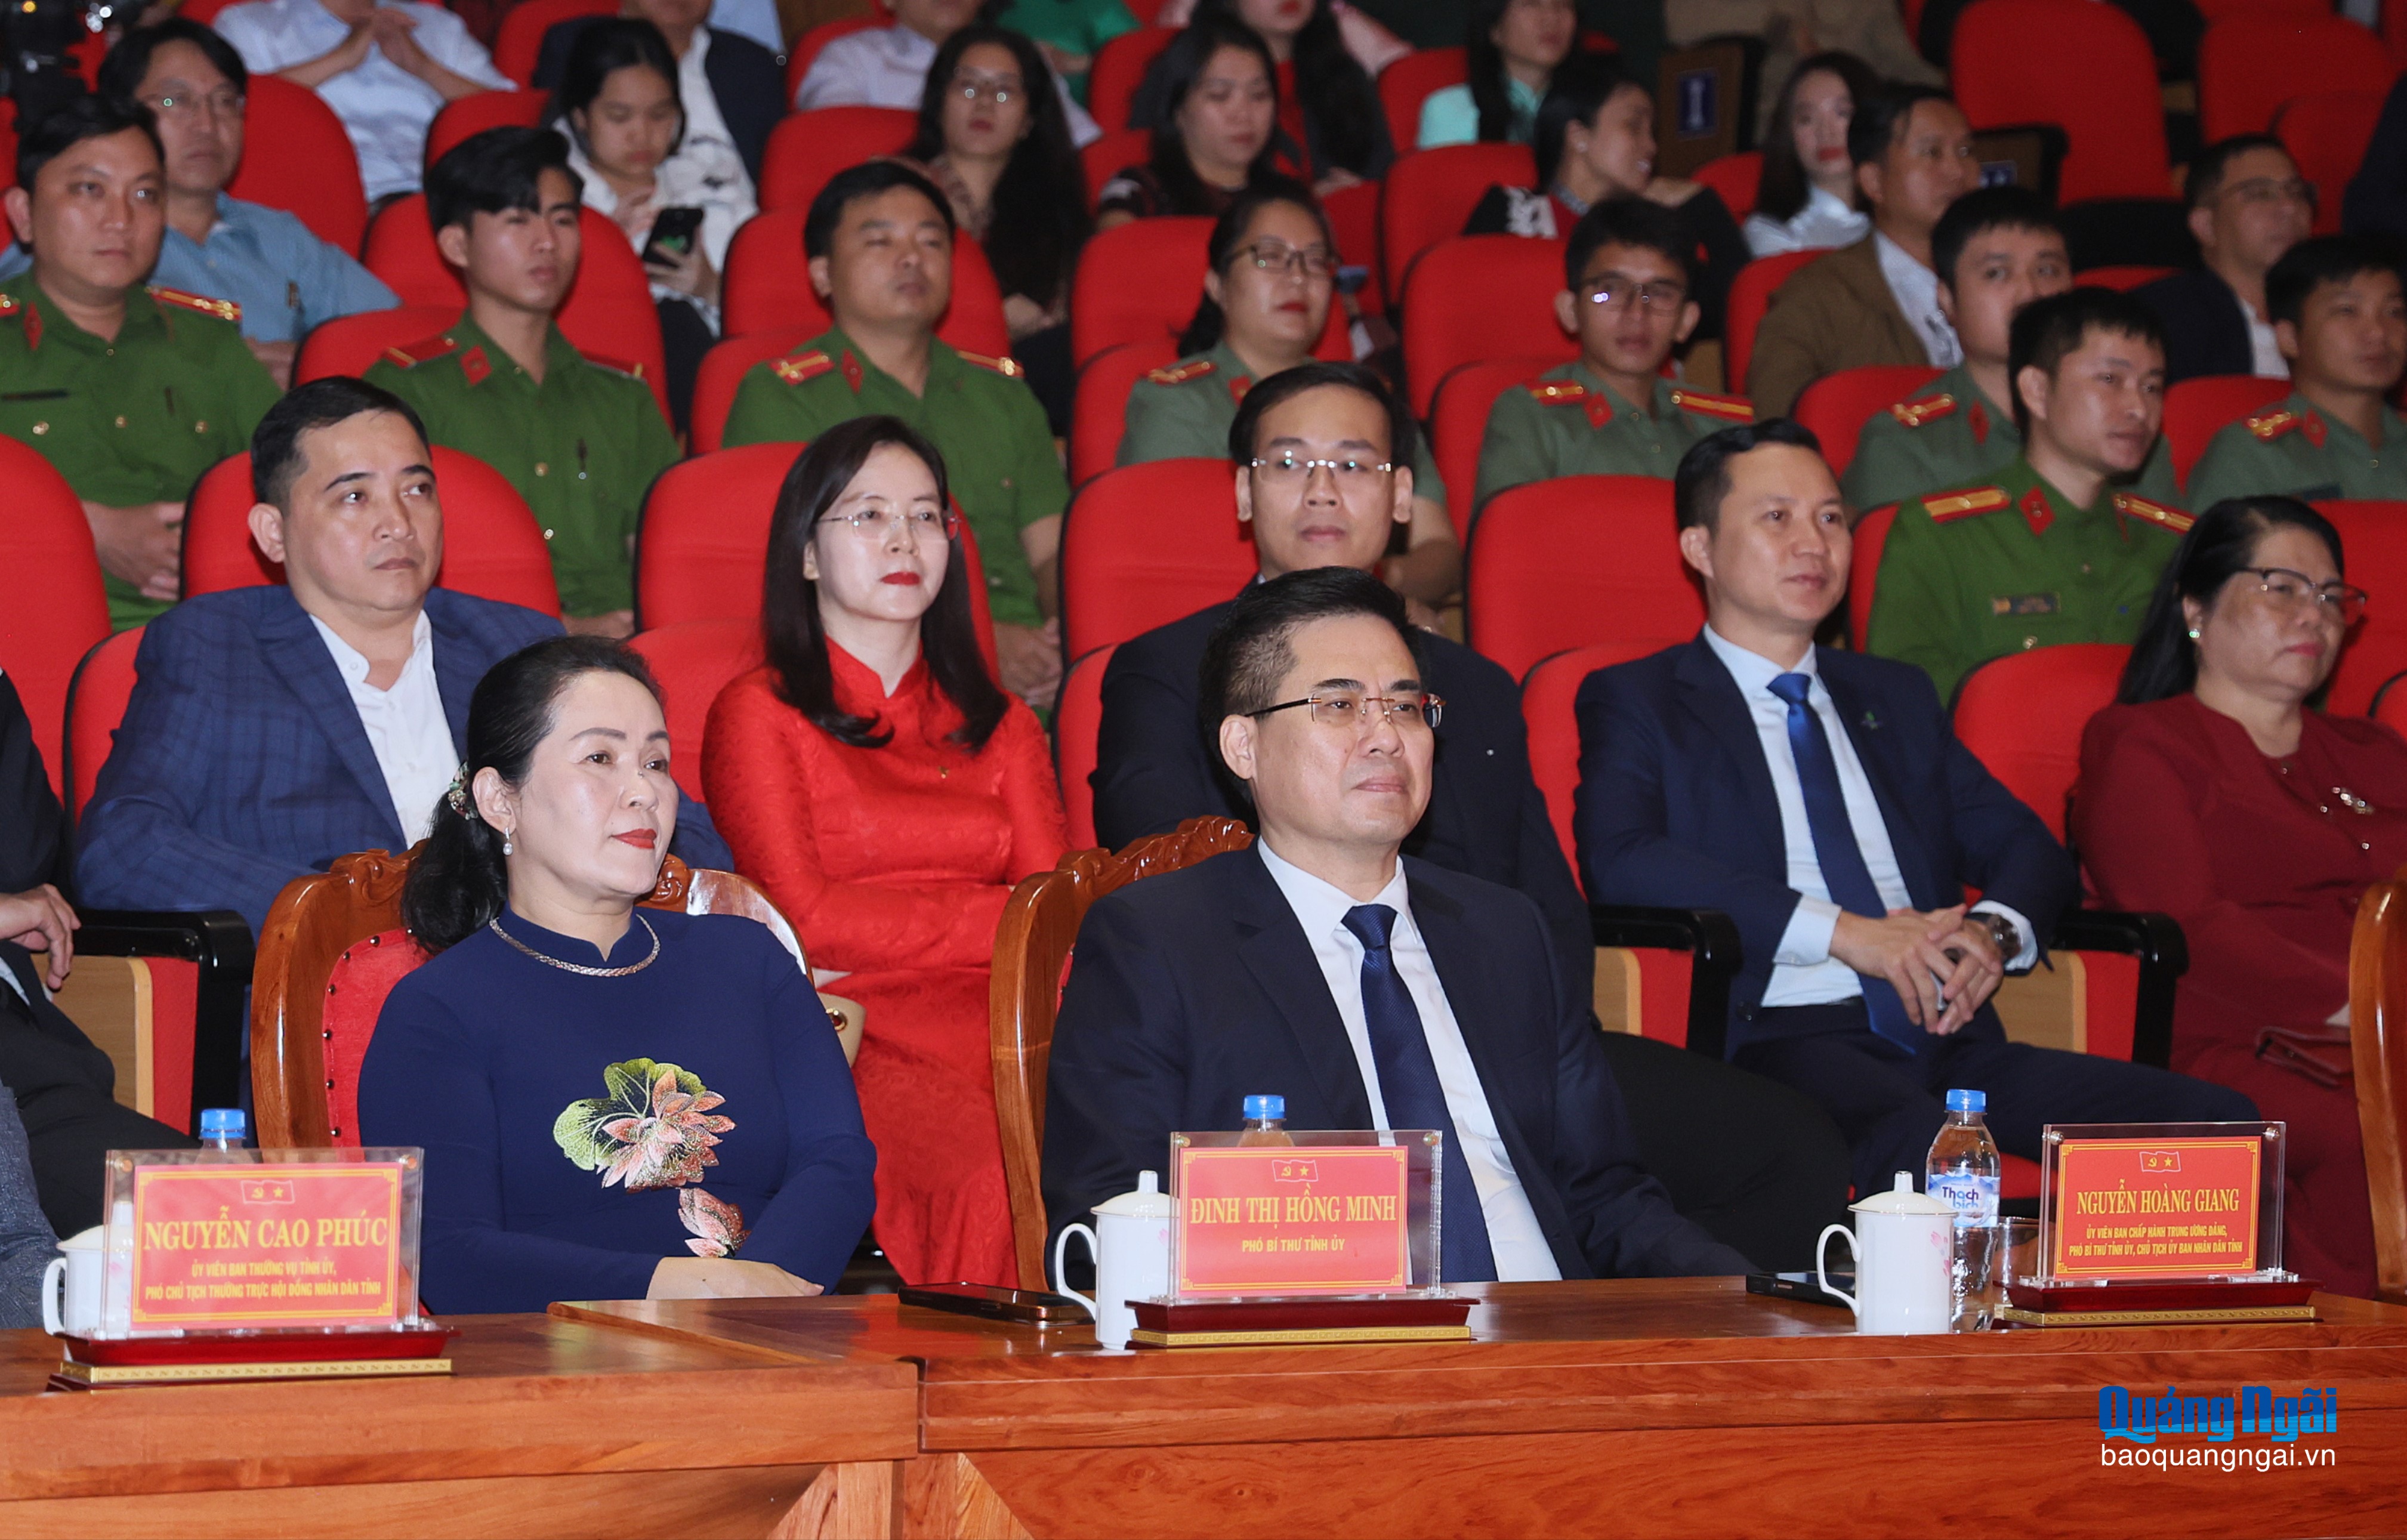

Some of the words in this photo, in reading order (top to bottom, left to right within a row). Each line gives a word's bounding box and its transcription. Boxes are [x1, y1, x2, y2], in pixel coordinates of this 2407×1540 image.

[2076, 1178, 2137, 1214] NGUYỄN
[2140, 1183, 2191, 1213] HOÀNG
[2195, 1189, 2239, 1212] GIANG
[1190, 1198, 1240, 1223] ĐINH
[1246, 1197, 1280, 1229] THỊ
[1285, 1183, 1341, 1223] HỒNG
[1346, 1196, 1396, 1221] MINH
[143, 1205, 251, 1251] NGUYỄN
[258, 1218, 310, 1248] CAO
[316, 1209, 387, 1246] PHÚC
[2114, 1227, 2127, 1238] BAN
[2129, 1223, 2147, 1238] CHẤP
[2167, 1226, 2189, 1237] TRUNG
[1242, 1237, 1263, 1252] PHÓ
[1267, 1237, 1277, 1251] BÍ
[1281, 1237, 1303, 1251] THƯ
[1304, 1235, 1328, 1251] TỈNH
[1331, 1234, 1346, 1251] ỦY
[2137, 1240, 2150, 1254] CHỦ
[2152, 1243, 2167, 1257] TỊCH
[2179, 1243, 2193, 1254] BAN
[229, 1263, 246, 1276] BAN
